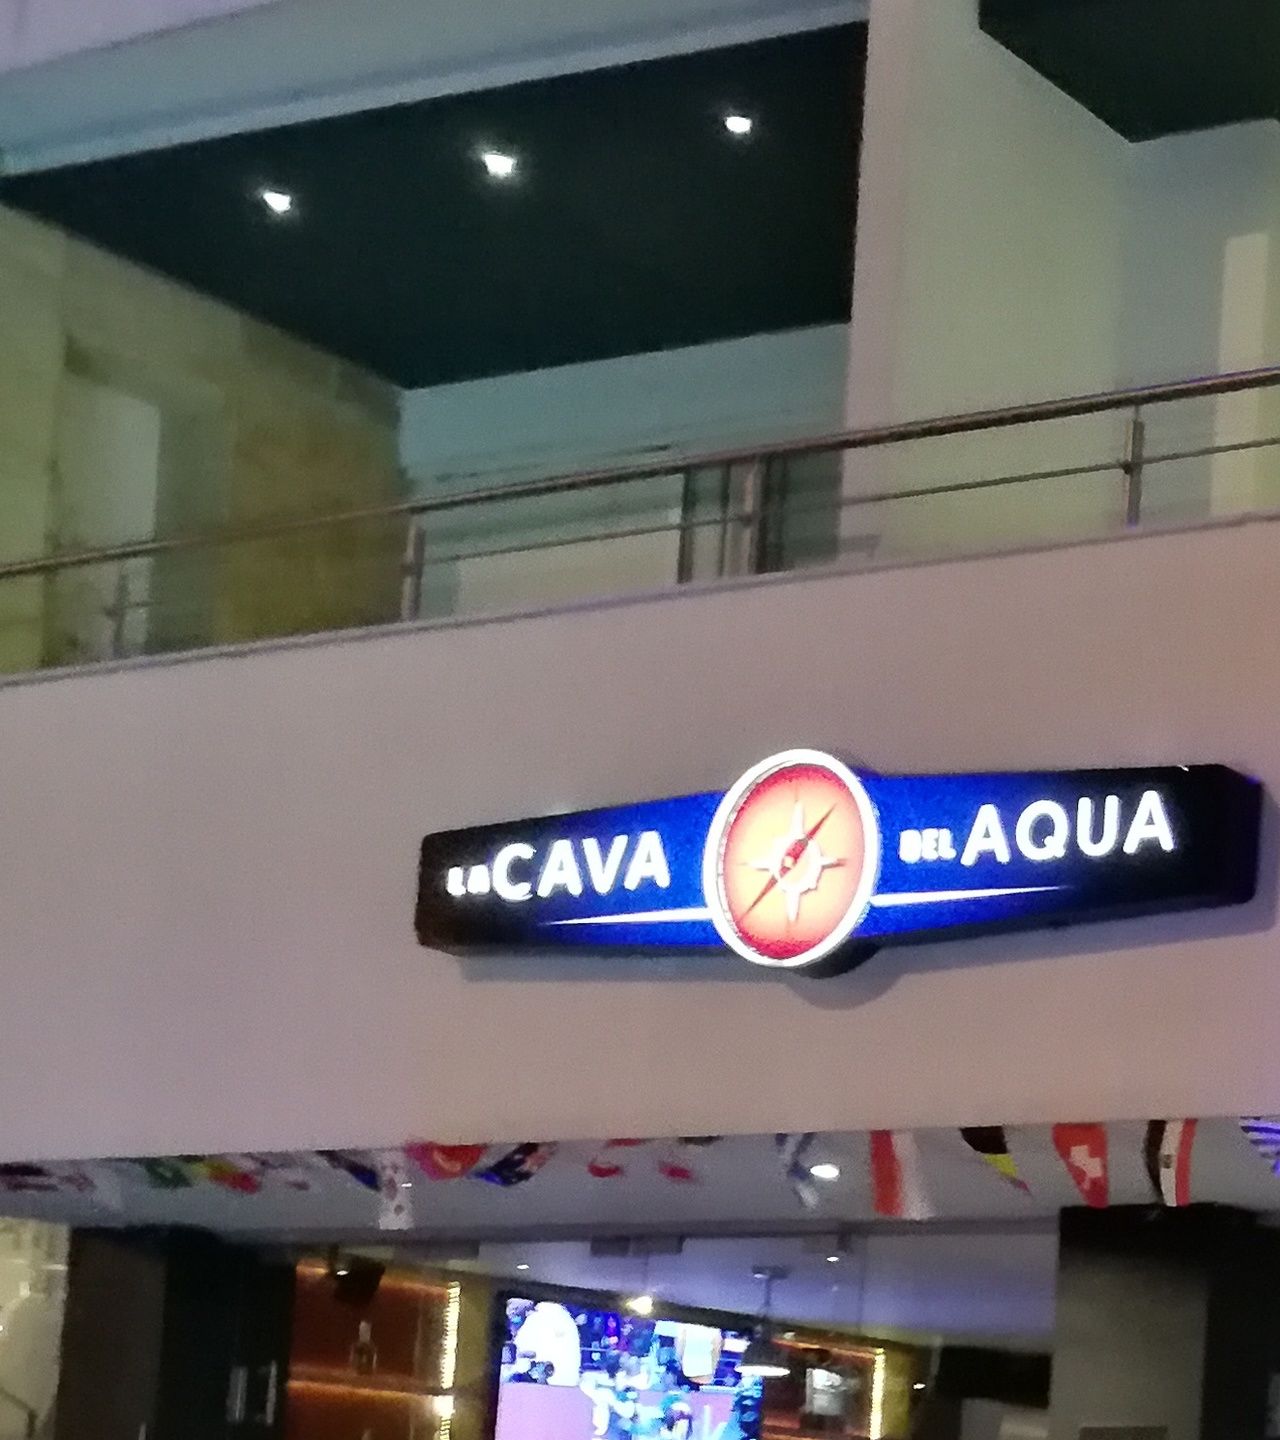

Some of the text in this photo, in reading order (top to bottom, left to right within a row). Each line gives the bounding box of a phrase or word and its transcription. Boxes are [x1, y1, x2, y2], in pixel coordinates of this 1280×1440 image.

[492, 830, 671, 901] CAVA
[899, 827, 957, 863] DEL
[959, 790, 1174, 866] AQUA
